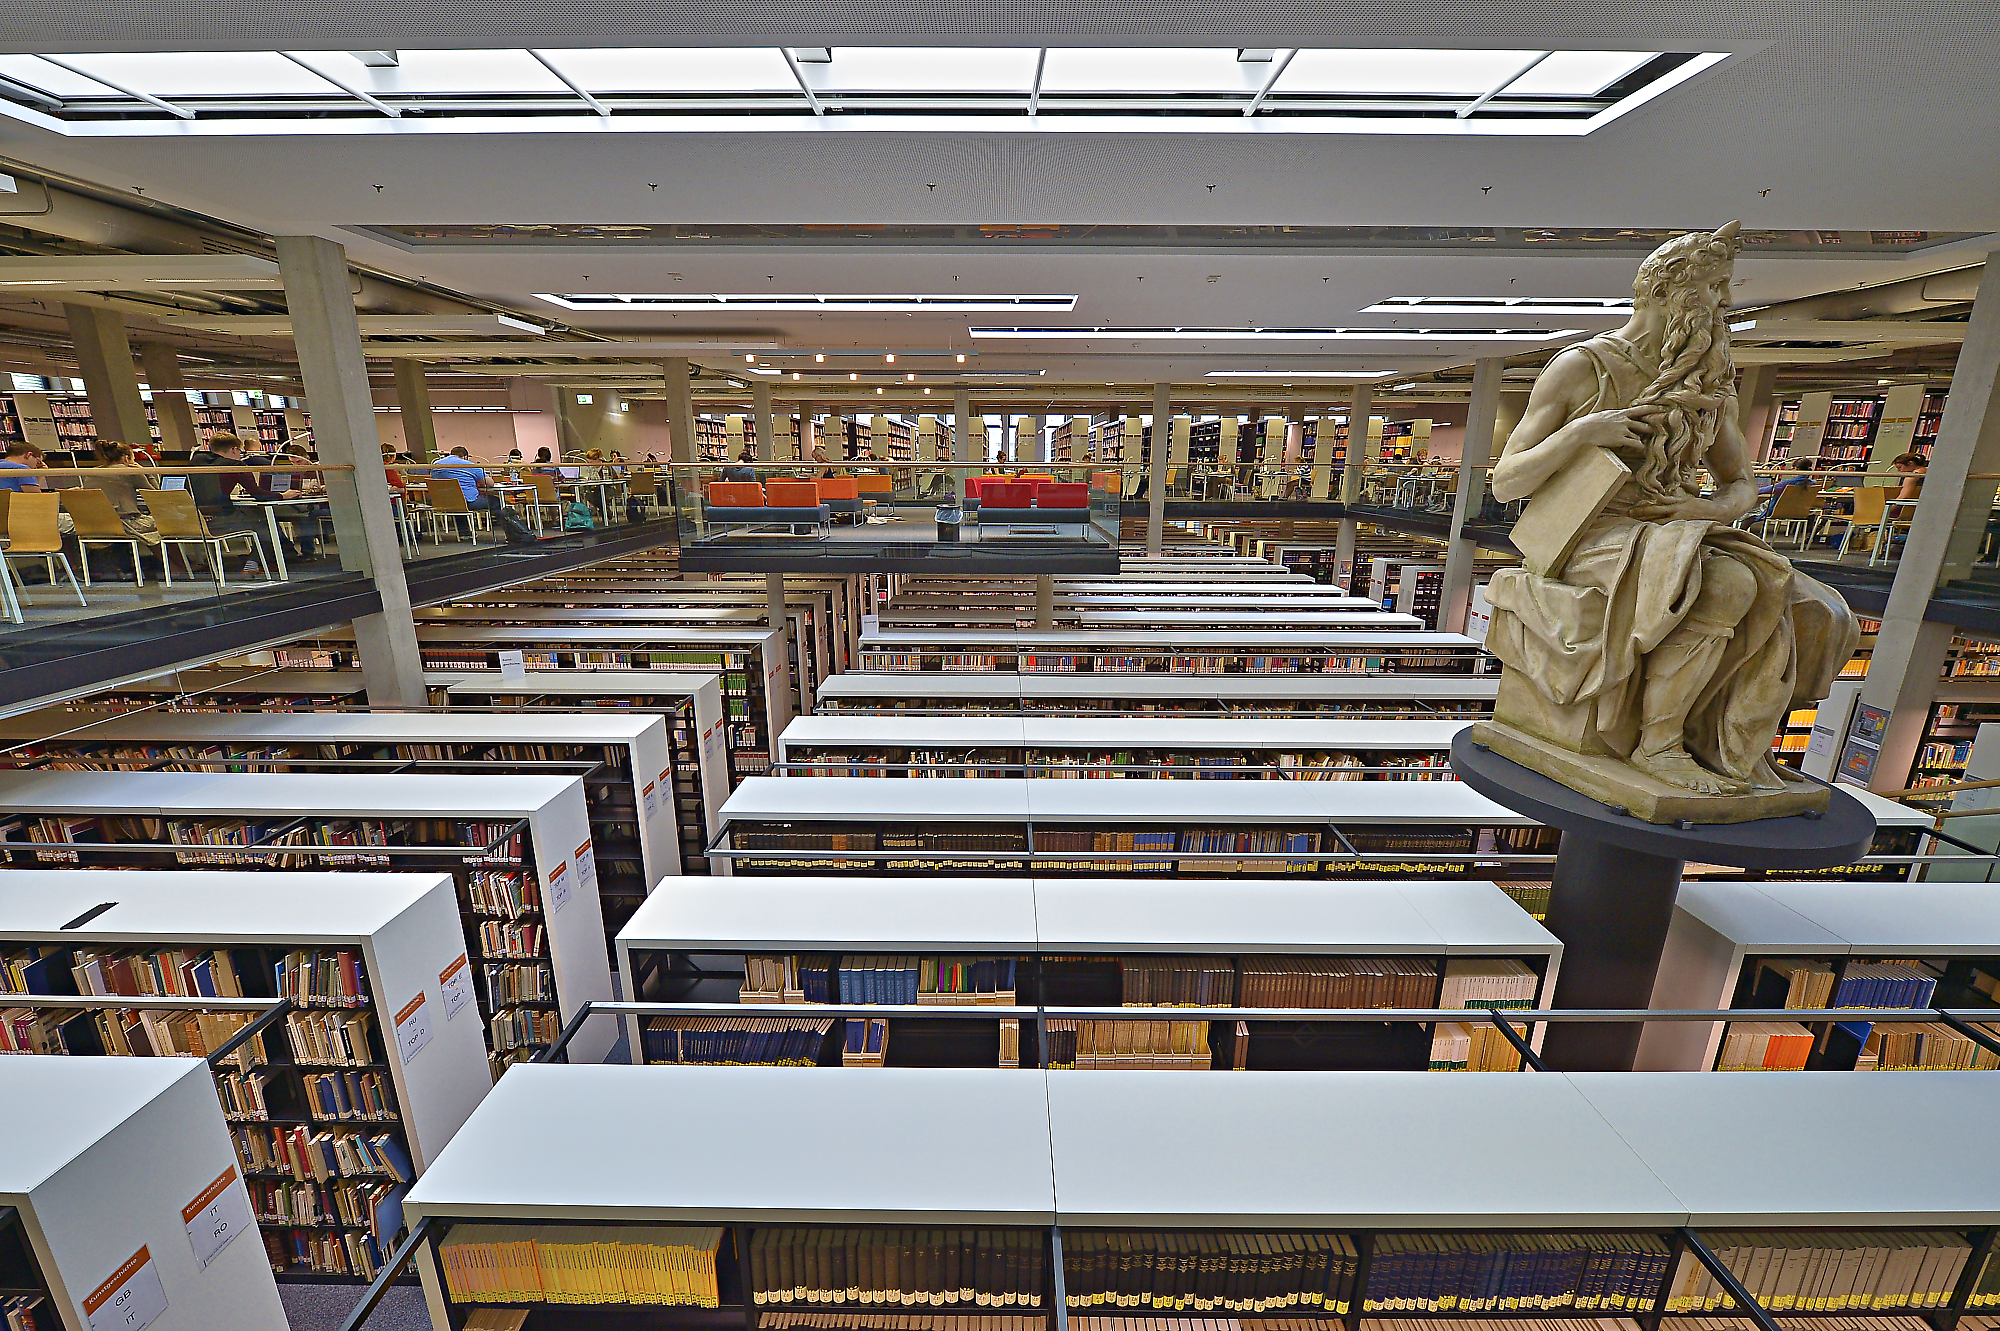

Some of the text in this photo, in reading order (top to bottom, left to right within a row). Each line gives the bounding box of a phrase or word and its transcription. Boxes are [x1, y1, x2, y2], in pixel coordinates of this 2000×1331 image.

[447, 978, 457, 989] TOP
[450, 992, 461, 1004] TOP
[408, 1016, 417, 1028] RU
[407, 1028, 425, 1047] TOP D
[186, 1176, 226, 1214] Kunstgeschichte
[209, 1204, 219, 1217] IT
[213, 1222, 228, 1238] RO
[88, 1257, 138, 1305] Kunstgeschichte
[115, 1288, 132, 1308] GB
[125, 1311, 136, 1326] IT
